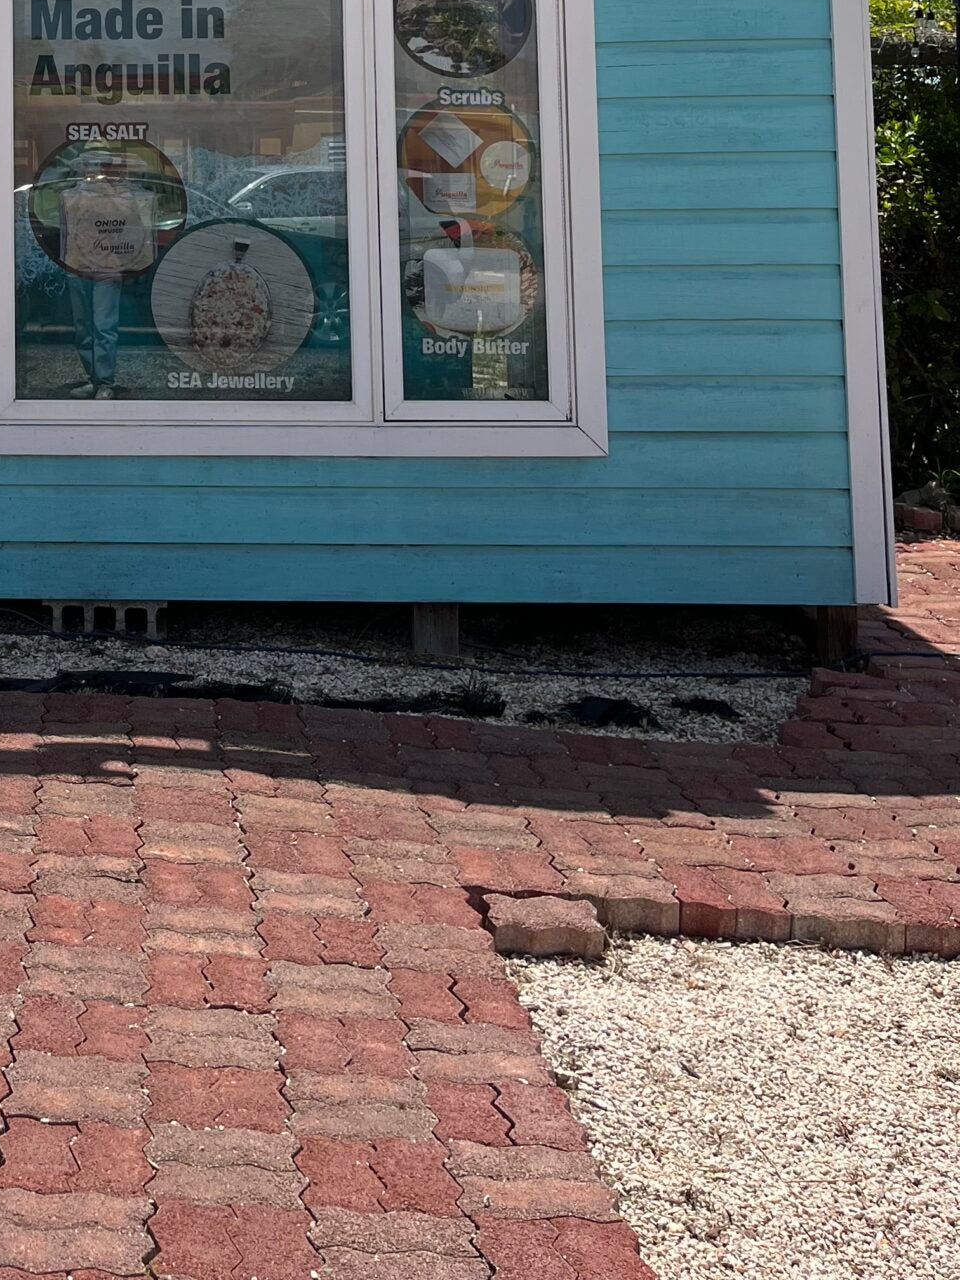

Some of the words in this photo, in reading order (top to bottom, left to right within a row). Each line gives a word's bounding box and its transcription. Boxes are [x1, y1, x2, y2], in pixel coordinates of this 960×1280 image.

[30, 0, 163, 41] Made
[29, 53, 232, 106] Anguilla
[439, 89, 503, 106] Scrubs
[67, 125, 101, 141] SEA
[106, 124, 146, 140] SALT
[94, 220, 126, 228] ONION
[422, 339, 467, 358] Body
[473, 339, 529, 355] Butter
[168, 373, 202, 389] SEA
[207, 373, 295, 393] Jewellery
